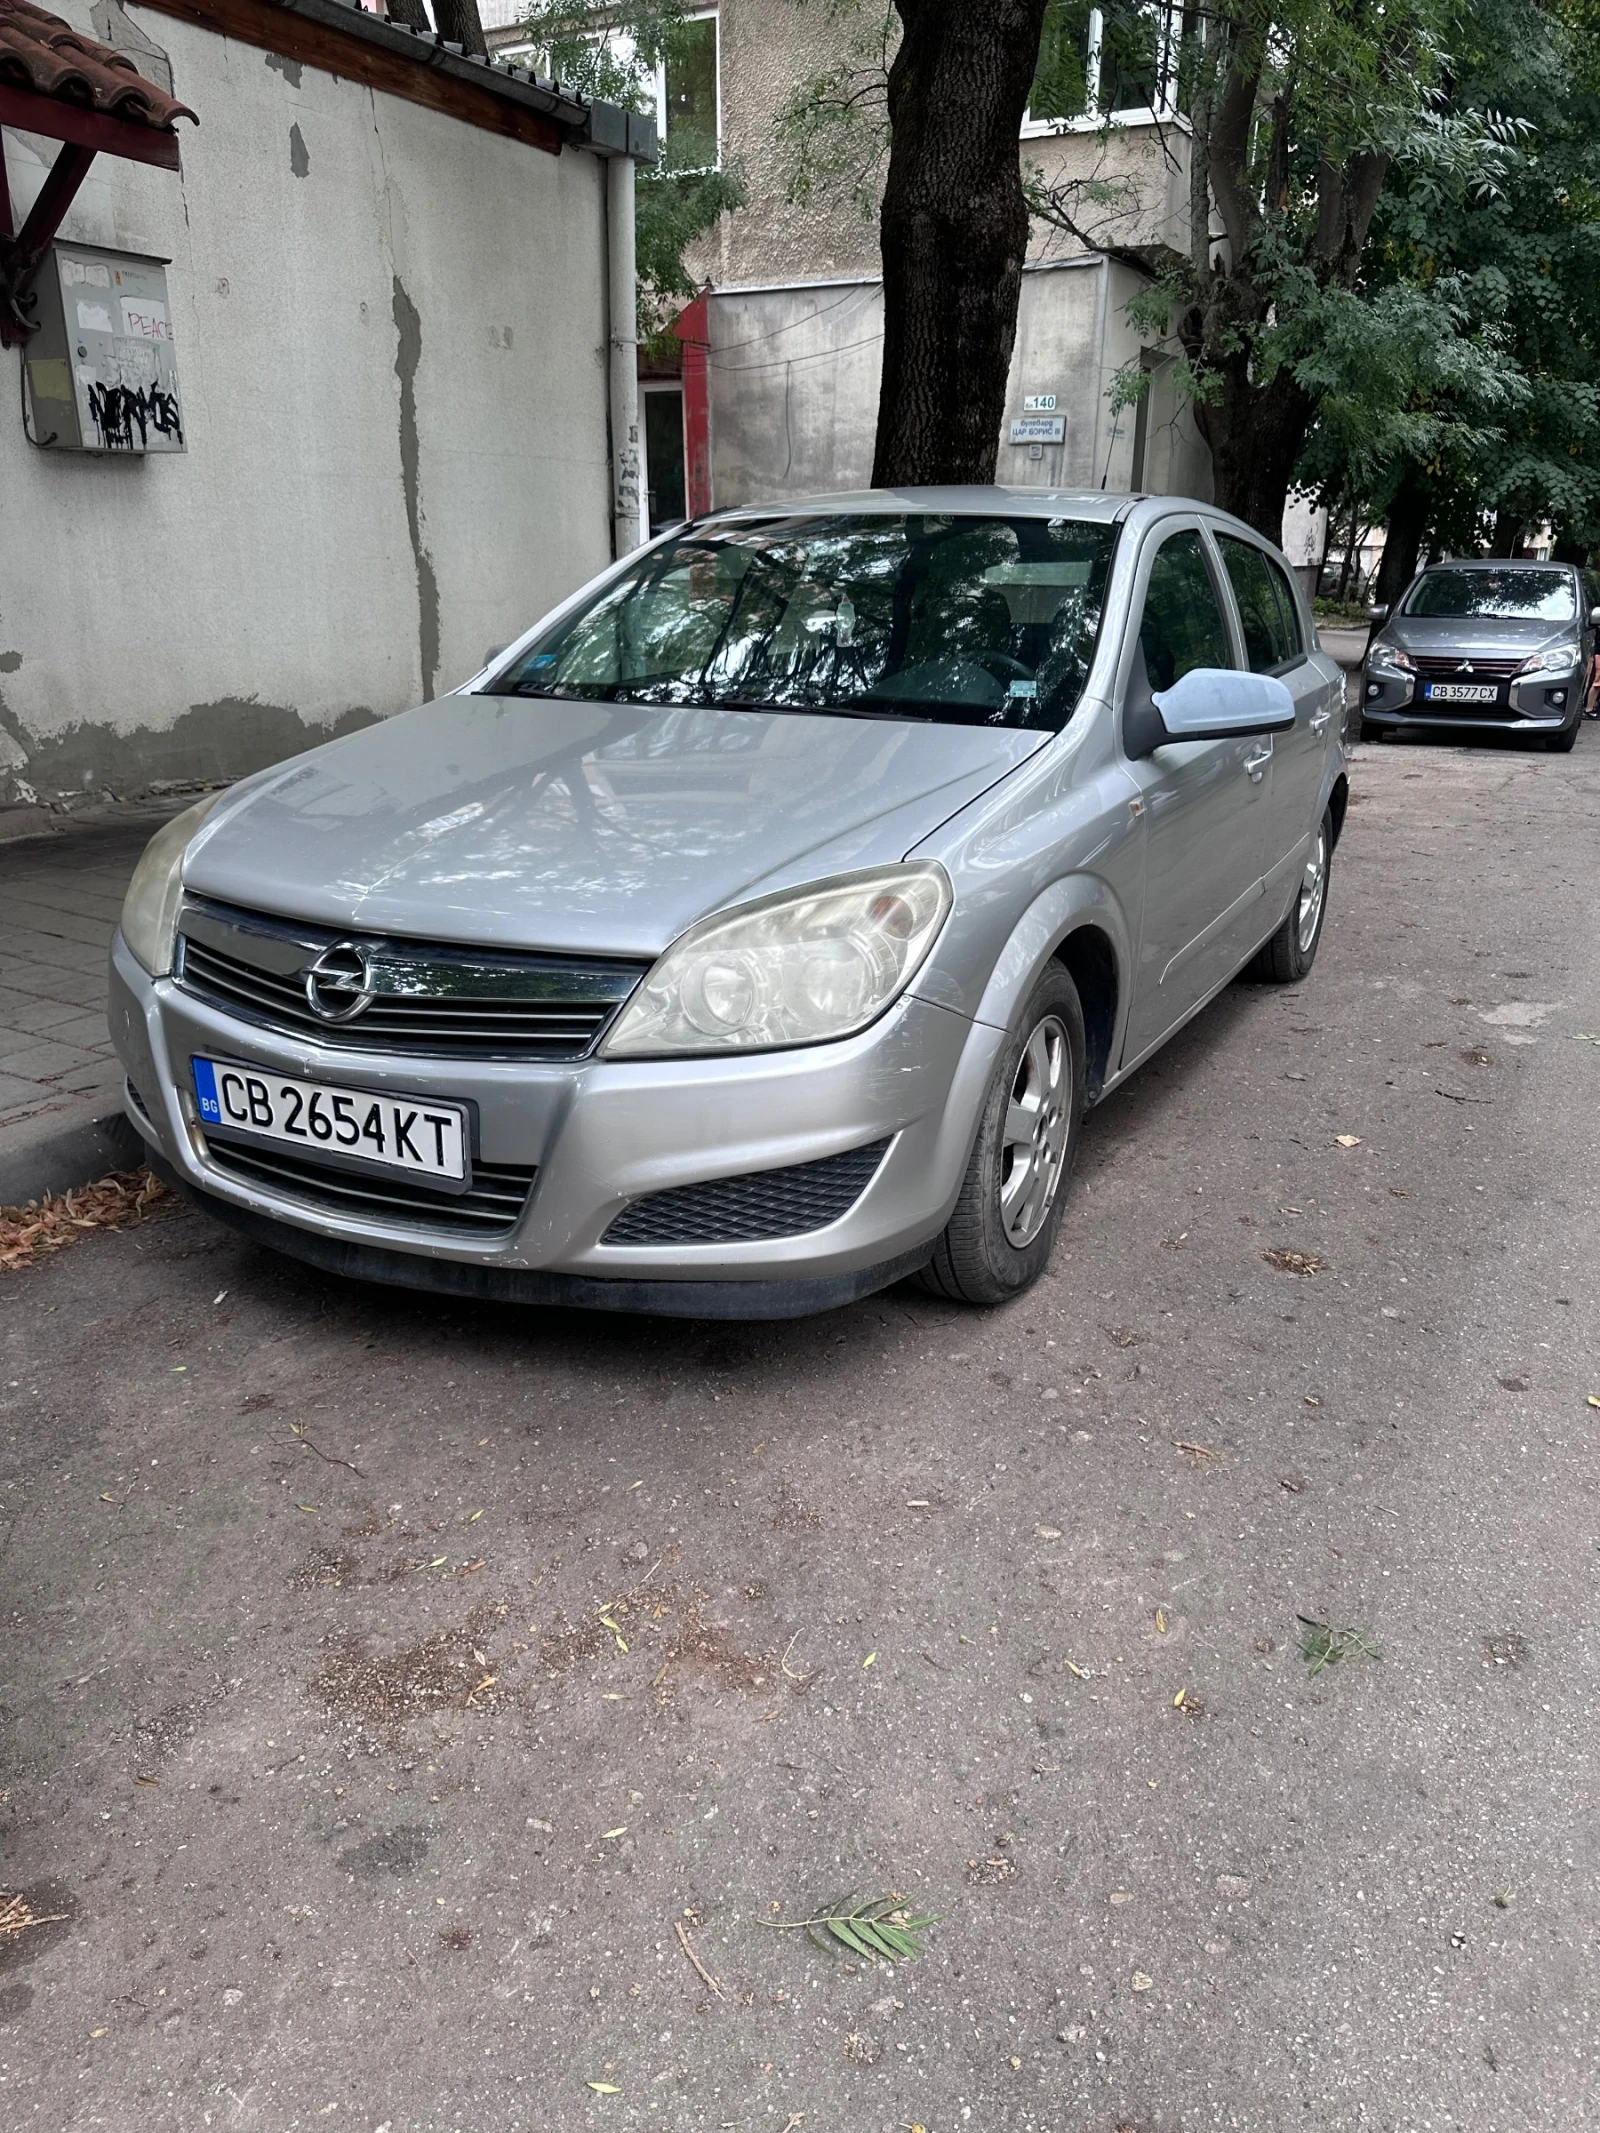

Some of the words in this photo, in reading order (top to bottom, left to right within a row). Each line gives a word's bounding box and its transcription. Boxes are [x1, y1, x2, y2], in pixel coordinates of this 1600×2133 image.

[127, 311, 174, 341] PEACE
[1033, 396, 1054, 408] 140
[1012, 428, 1027, 436] ЦАР
[1449, 686, 1478, 698] 3577
[201, 1097, 219, 1114] BG
